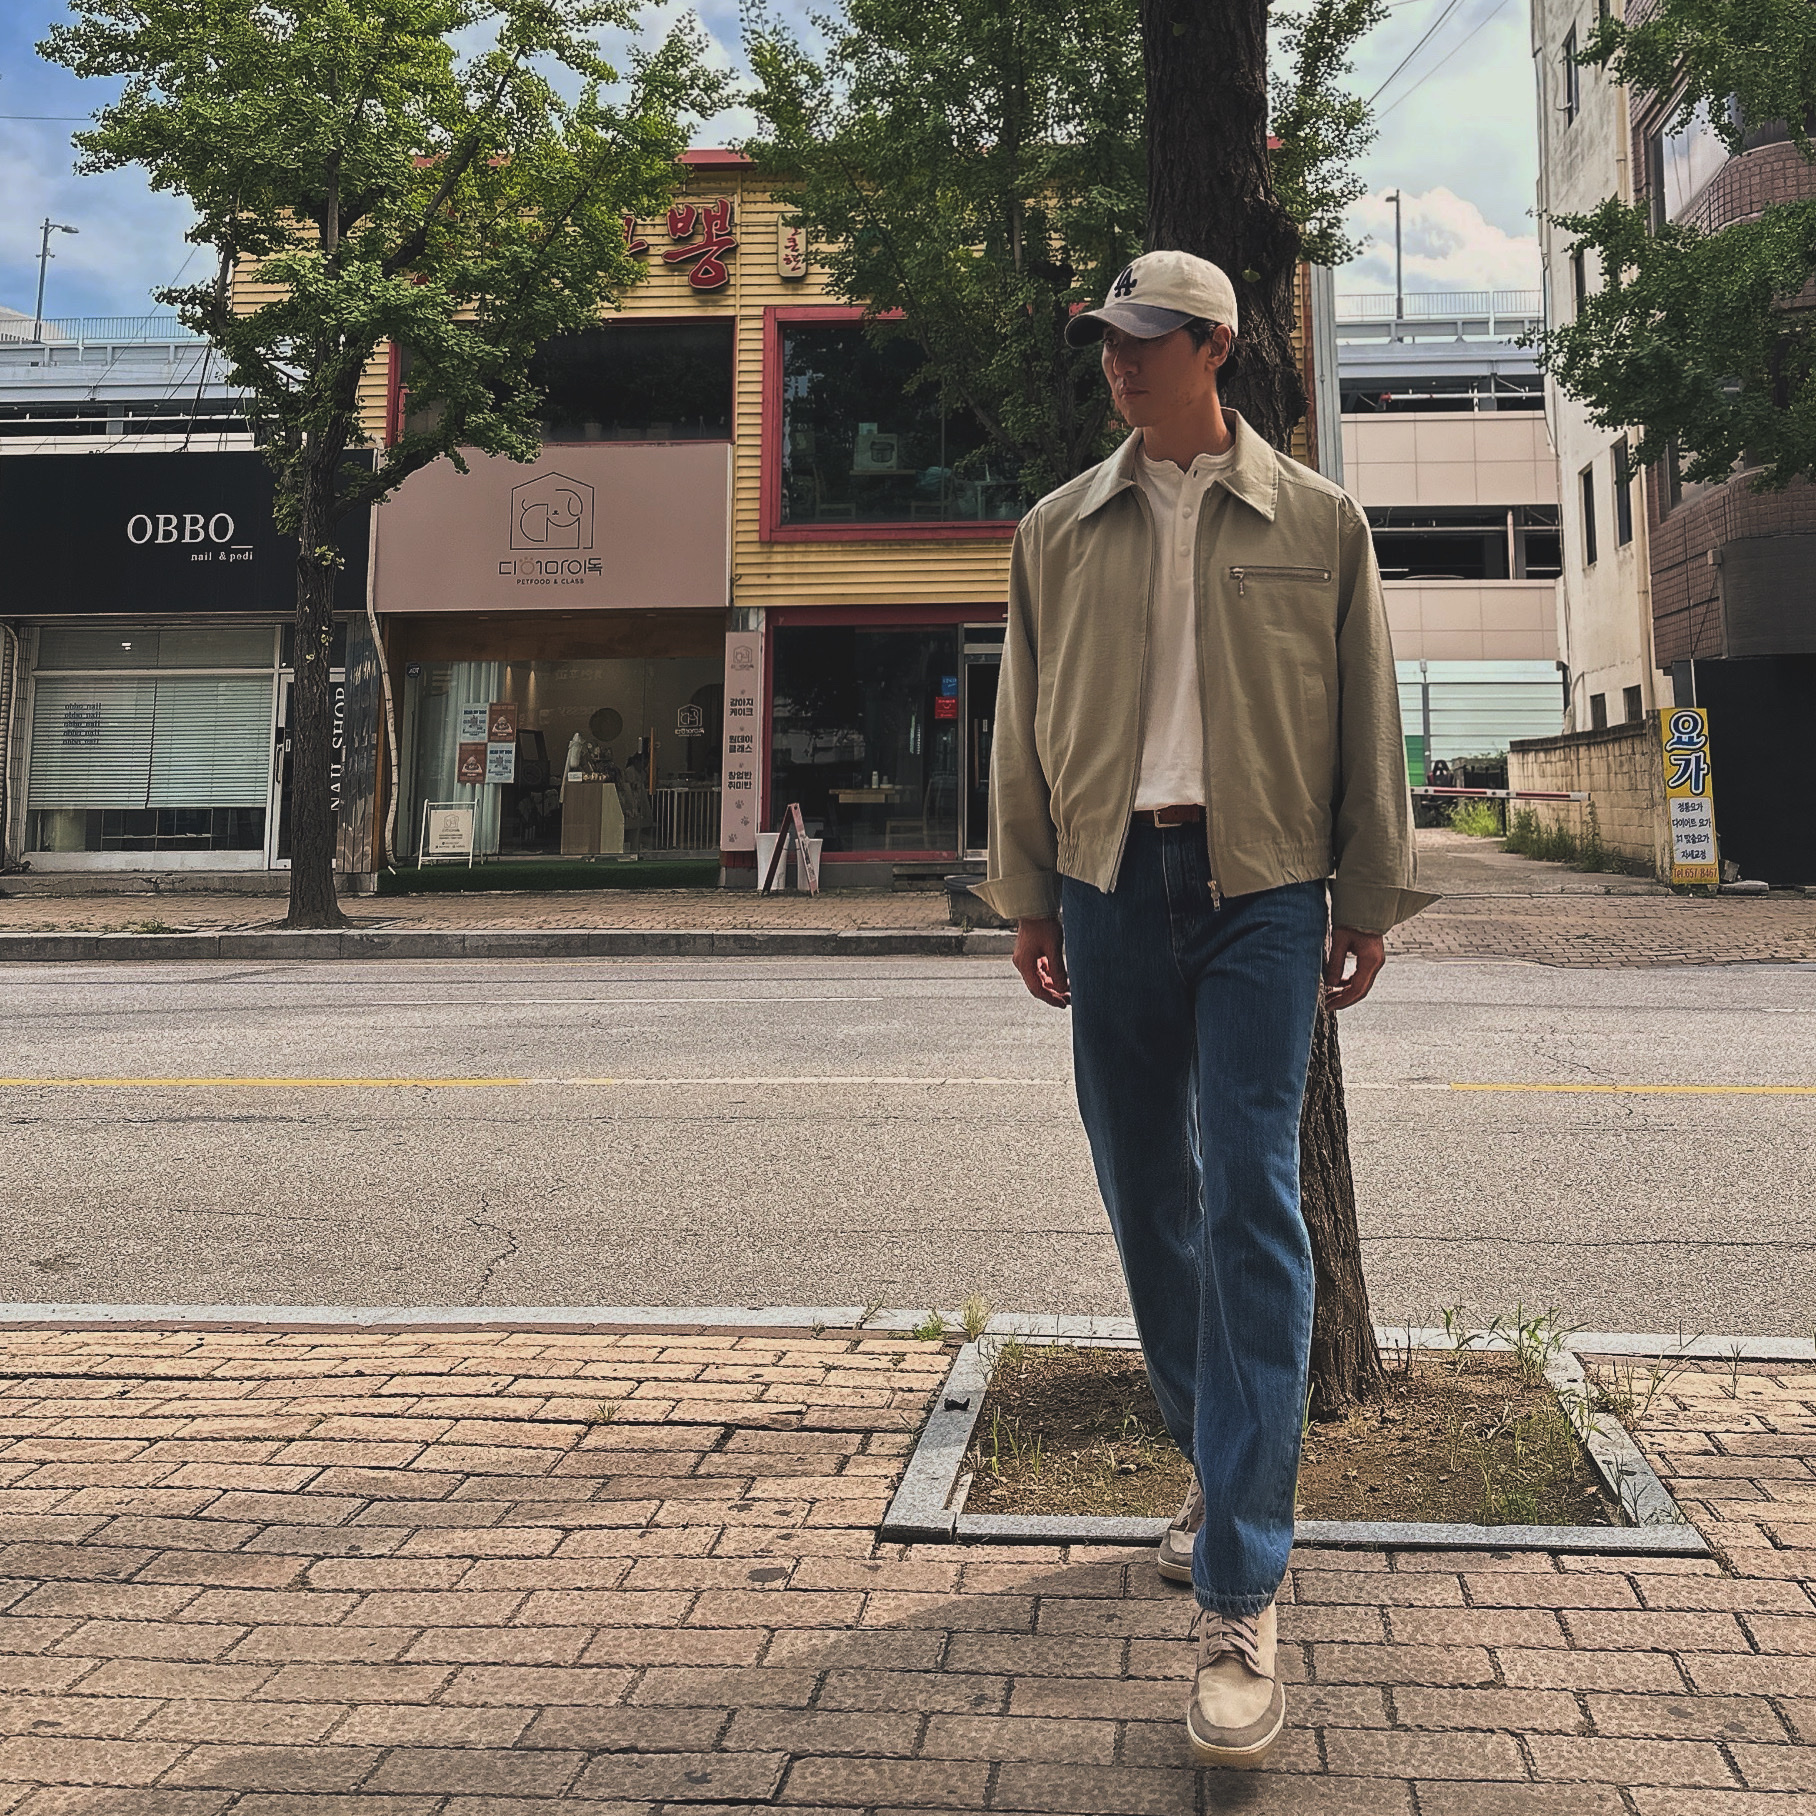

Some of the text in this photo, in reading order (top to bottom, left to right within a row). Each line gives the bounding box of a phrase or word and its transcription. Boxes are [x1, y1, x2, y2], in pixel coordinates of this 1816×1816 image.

[191, 552, 253, 562] nail & pedi
[729, 698, 754, 707] 강아지
[729, 708, 754, 716] 케이크
[729, 735, 753, 744] 원데이
[728, 744, 753, 753] 클래스
[1666, 711, 1709, 795] 요가
[728, 781, 752, 790] 취미반
[1677, 801, 1703, 813] 정통요가
[1672, 817, 1711, 828] 다이어트 요가
[1684, 833, 1710, 844] 맞춤요가
[1681, 849, 1707, 860] 자세교정
